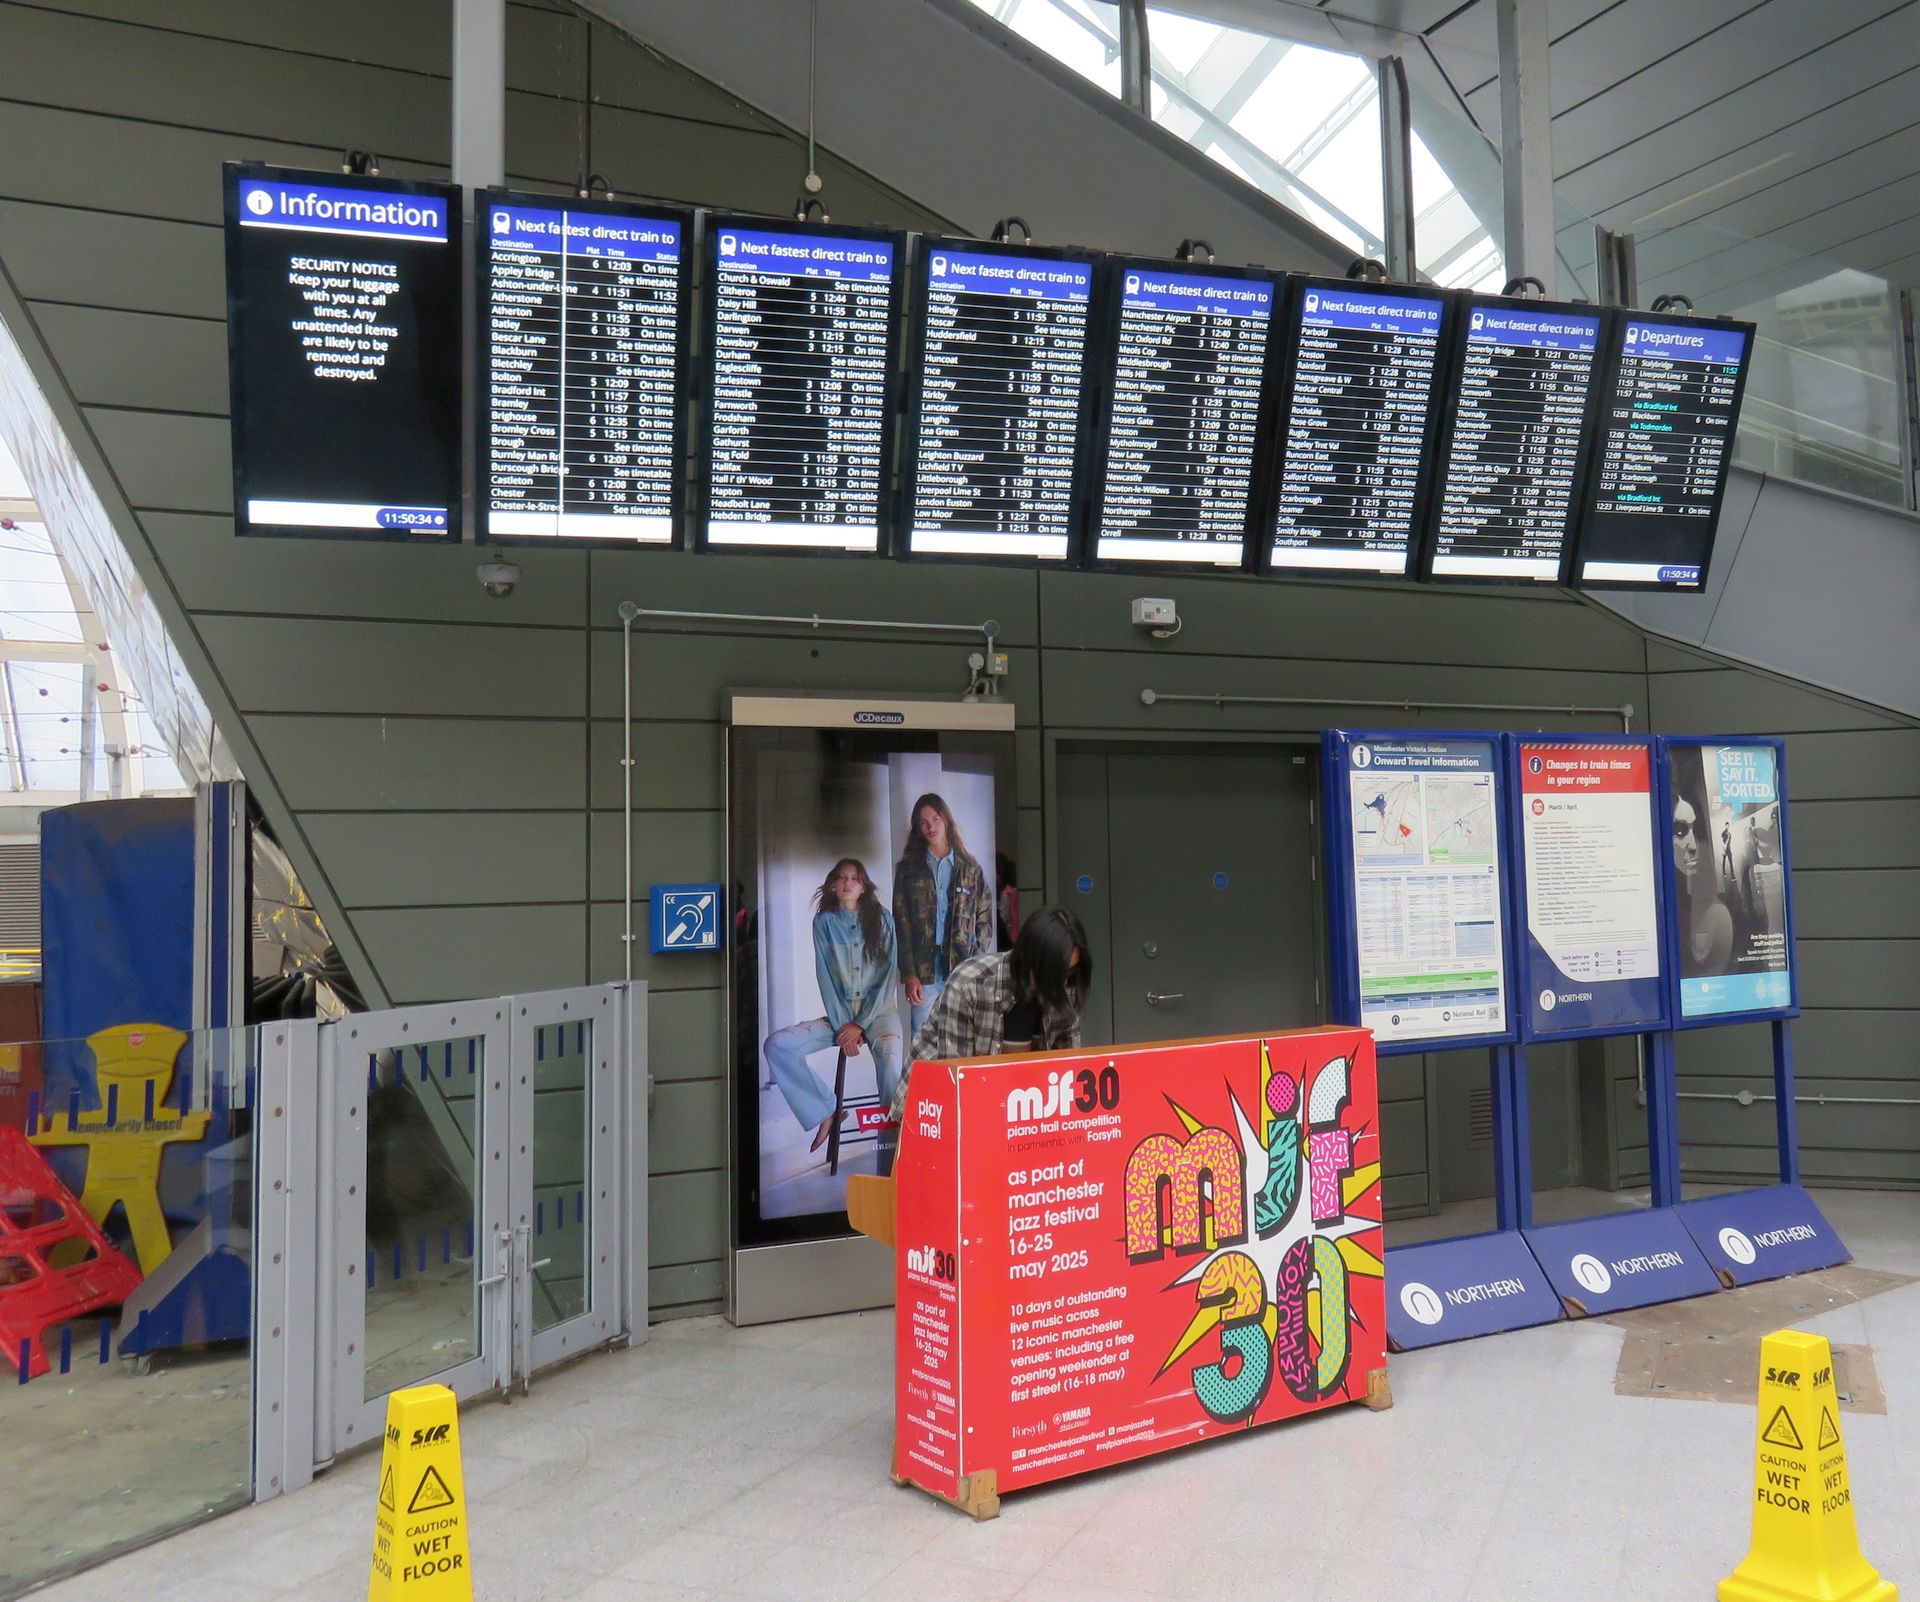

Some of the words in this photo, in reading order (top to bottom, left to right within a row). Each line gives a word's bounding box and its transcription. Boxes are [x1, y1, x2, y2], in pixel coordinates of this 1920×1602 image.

[280, 192, 438, 228] Information
[492, 252, 541, 264] Accrington
[593, 260, 599, 269] 6
[608, 261, 632, 271] 12:03
[642, 264, 657, 273] On
[658, 265, 678, 275] time
[741, 242, 768, 254] Next
[771, 244, 809, 258] fastest
[812, 247, 844, 261] direct
[847, 251, 872, 263] train
[875, 254, 887, 265] to
[291, 258, 349, 272] SECURITY
[352, 263, 397, 276] NOTICE
[289, 273, 320, 288] Keep
[323, 277, 350, 289] your
[353, 277, 399, 293] luggage
[1144, 282, 1166, 293] Next
[1169, 284, 1201, 296] fastest
[1204, 287, 1231, 299] direct
[1234, 290, 1255, 301] train
[1258, 293, 1268, 302] to
[303, 290, 329, 302] with
[332, 293, 354, 304] you
[357, 294, 369, 305] at
[372, 295, 386, 306] all
[314, 306, 351, 318] times.
[353, 308, 376, 322] Any
[1122, 310, 1164, 321] Manchester
[1166, 313, 1191, 323] Airport
[1213, 317, 1232, 326] 12:40
[1252, 321, 1268, 329] time
[292, 321, 362, 334] unattended
[365, 324, 398, 336] items
[1487, 319, 1506, 328] Next
[1509, 320, 1537, 331] fastest
[1539, 324, 1562, 333] direct
[1564, 326, 1583, 335] train
[1586, 328, 1594, 336] to
[303, 336, 322, 346] are
[325, 336, 355, 351] likely
[358, 339, 371, 350] to
[373, 340, 388, 351] be
[1641, 330, 1704, 347] Departures
[307, 351, 359, 364] removed
[362, 354, 385, 366] and
[1641, 360, 1673, 369] Stalybridge
[1722, 366, 1738, 374] 11:52
[314, 366, 377, 380] destroyed.
[385, 513, 432, 524] 11:50:34
[856, 713, 902, 722] JCDecaux
[1374, 756, 1406, 765] Onward
[1407, 756, 1430, 766] Travel
[1432, 758, 1479, 766] Information
[1547, 760, 1578, 771] Changes
[1580, 761, 1588, 769] to
[1590, 760, 1608, 769] train
[1610, 760, 1631, 769] times
[1721, 752, 1741, 765] SEE
[1744, 752, 1755, 765] IT.
[1548, 775, 1554, 784] in
[1557, 776, 1575, 786] your
[1577, 775, 1600, 786] region
[1722, 768, 1743, 781] SAY
[1745, 768, 1758, 781] IT.
[1723, 783, 1773, 797] SORTED.
[1559, 993, 1592, 1003] NORTHERN
[1007, 1067, 1119, 1122] mjf30
[918, 1099, 942, 1120] play
[920, 1122, 941, 1139] me!
[1007, 1124, 1038, 1139] piano
[1041, 1121, 1059, 1133] trail
[1062, 1114, 1121, 1131] competition
[1007, 1142, 1015, 1152] in
[1068, 1135, 1085, 1146] with
[1087, 1128, 1121, 1142] Forsyth
[1008, 1172, 1027, 1185] as
[1032, 1163, 1064, 1186] part
[1068, 1160, 1084, 1177] of
[1009, 1183, 1104, 1209] manchester
[1009, 1213, 1040, 1236] jazz
[1044, 1203, 1099, 1226] festival
[1010, 1233, 1053, 1255] 16-25
[1753, 1224, 1817, 1248] NORTHERN
[908, 1245, 955, 1281] mjf30
[1010, 1261, 1046, 1279] may
[1051, 1250, 1088, 1272] 2025
[1611, 1251, 1683, 1277] NORTHERN
[1012, 1305, 1023, 1316] 10
[1026, 1301, 1052, 1314] days
[1054, 1297, 1065, 1308] of
[1067, 1286, 1127, 1306] outstanding
[1444, 1277, 1525, 1307] NORTHERN
[917, 1301, 924, 1310] as
[925, 1304, 938, 1316] part
[939, 1306, 945, 1318] of
[913, 1313, 949, 1332] manchester
[1011, 1321, 1029, 1334] live
[1032, 1315, 1063, 1329] music
[1066, 1308, 1099, 1322] across
[913, 1325, 926, 1338] jazz
[927, 1329, 948, 1346] festival
[1012, 1339, 1023, 1350] 12
[1026, 1333, 1059, 1348] iconic
[1062, 1320, 1123, 1339] manchester
[916, 1338, 932, 1353] 16-25
[933, 1345, 947, 1360] may
[1011, 1353, 1053, 1368] venues:
[1055, 1341, 1103, 1359] including
[1106, 1339, 1112, 1347] a
[1115, 1333, 1134, 1345] free
[924, 1354, 938, 1368] 2025
[1011, 1368, 1056, 1386] opening
[1059, 1355, 1117, 1374] weekender
[1119, 1349, 1129, 1361] at
[1011, 1391, 1029, 1402] first
[1032, 1383, 1061, 1398] street
[1064, 1373, 1096, 1391] (16-18
[1099, 1367, 1125, 1382] may)
[1765, 1367, 1800, 1387] SIR
[1813, 1367, 1830, 1387] SIR
[1012, 1420, 1046, 1438] Forsyth
[1062, 1407, 1091, 1422] YAMAHA
[410, 1424, 450, 1446] SIR
[1028, 1430, 1105, 1456] manchesterjazzfestival
[1013, 1449, 1084, 1472] manchesterjazz.com
[1760, 1454, 1806, 1473] CAUTION
[1819, 1453, 1844, 1473] CAUTION
[1767, 1470, 1800, 1490] WET
[1824, 1471, 1842, 1491] WET
[1758, 1488, 1810, 1514] FLOOR
[1822, 1489, 1850, 1515] FLOOR
[405, 1517, 458, 1537] CAUTION
[378, 1534, 390, 1556] WET
[413, 1535, 451, 1557] WET
[372, 1554, 392, 1582] FLOOR
[403, 1554, 463, 1583] FLOOR
